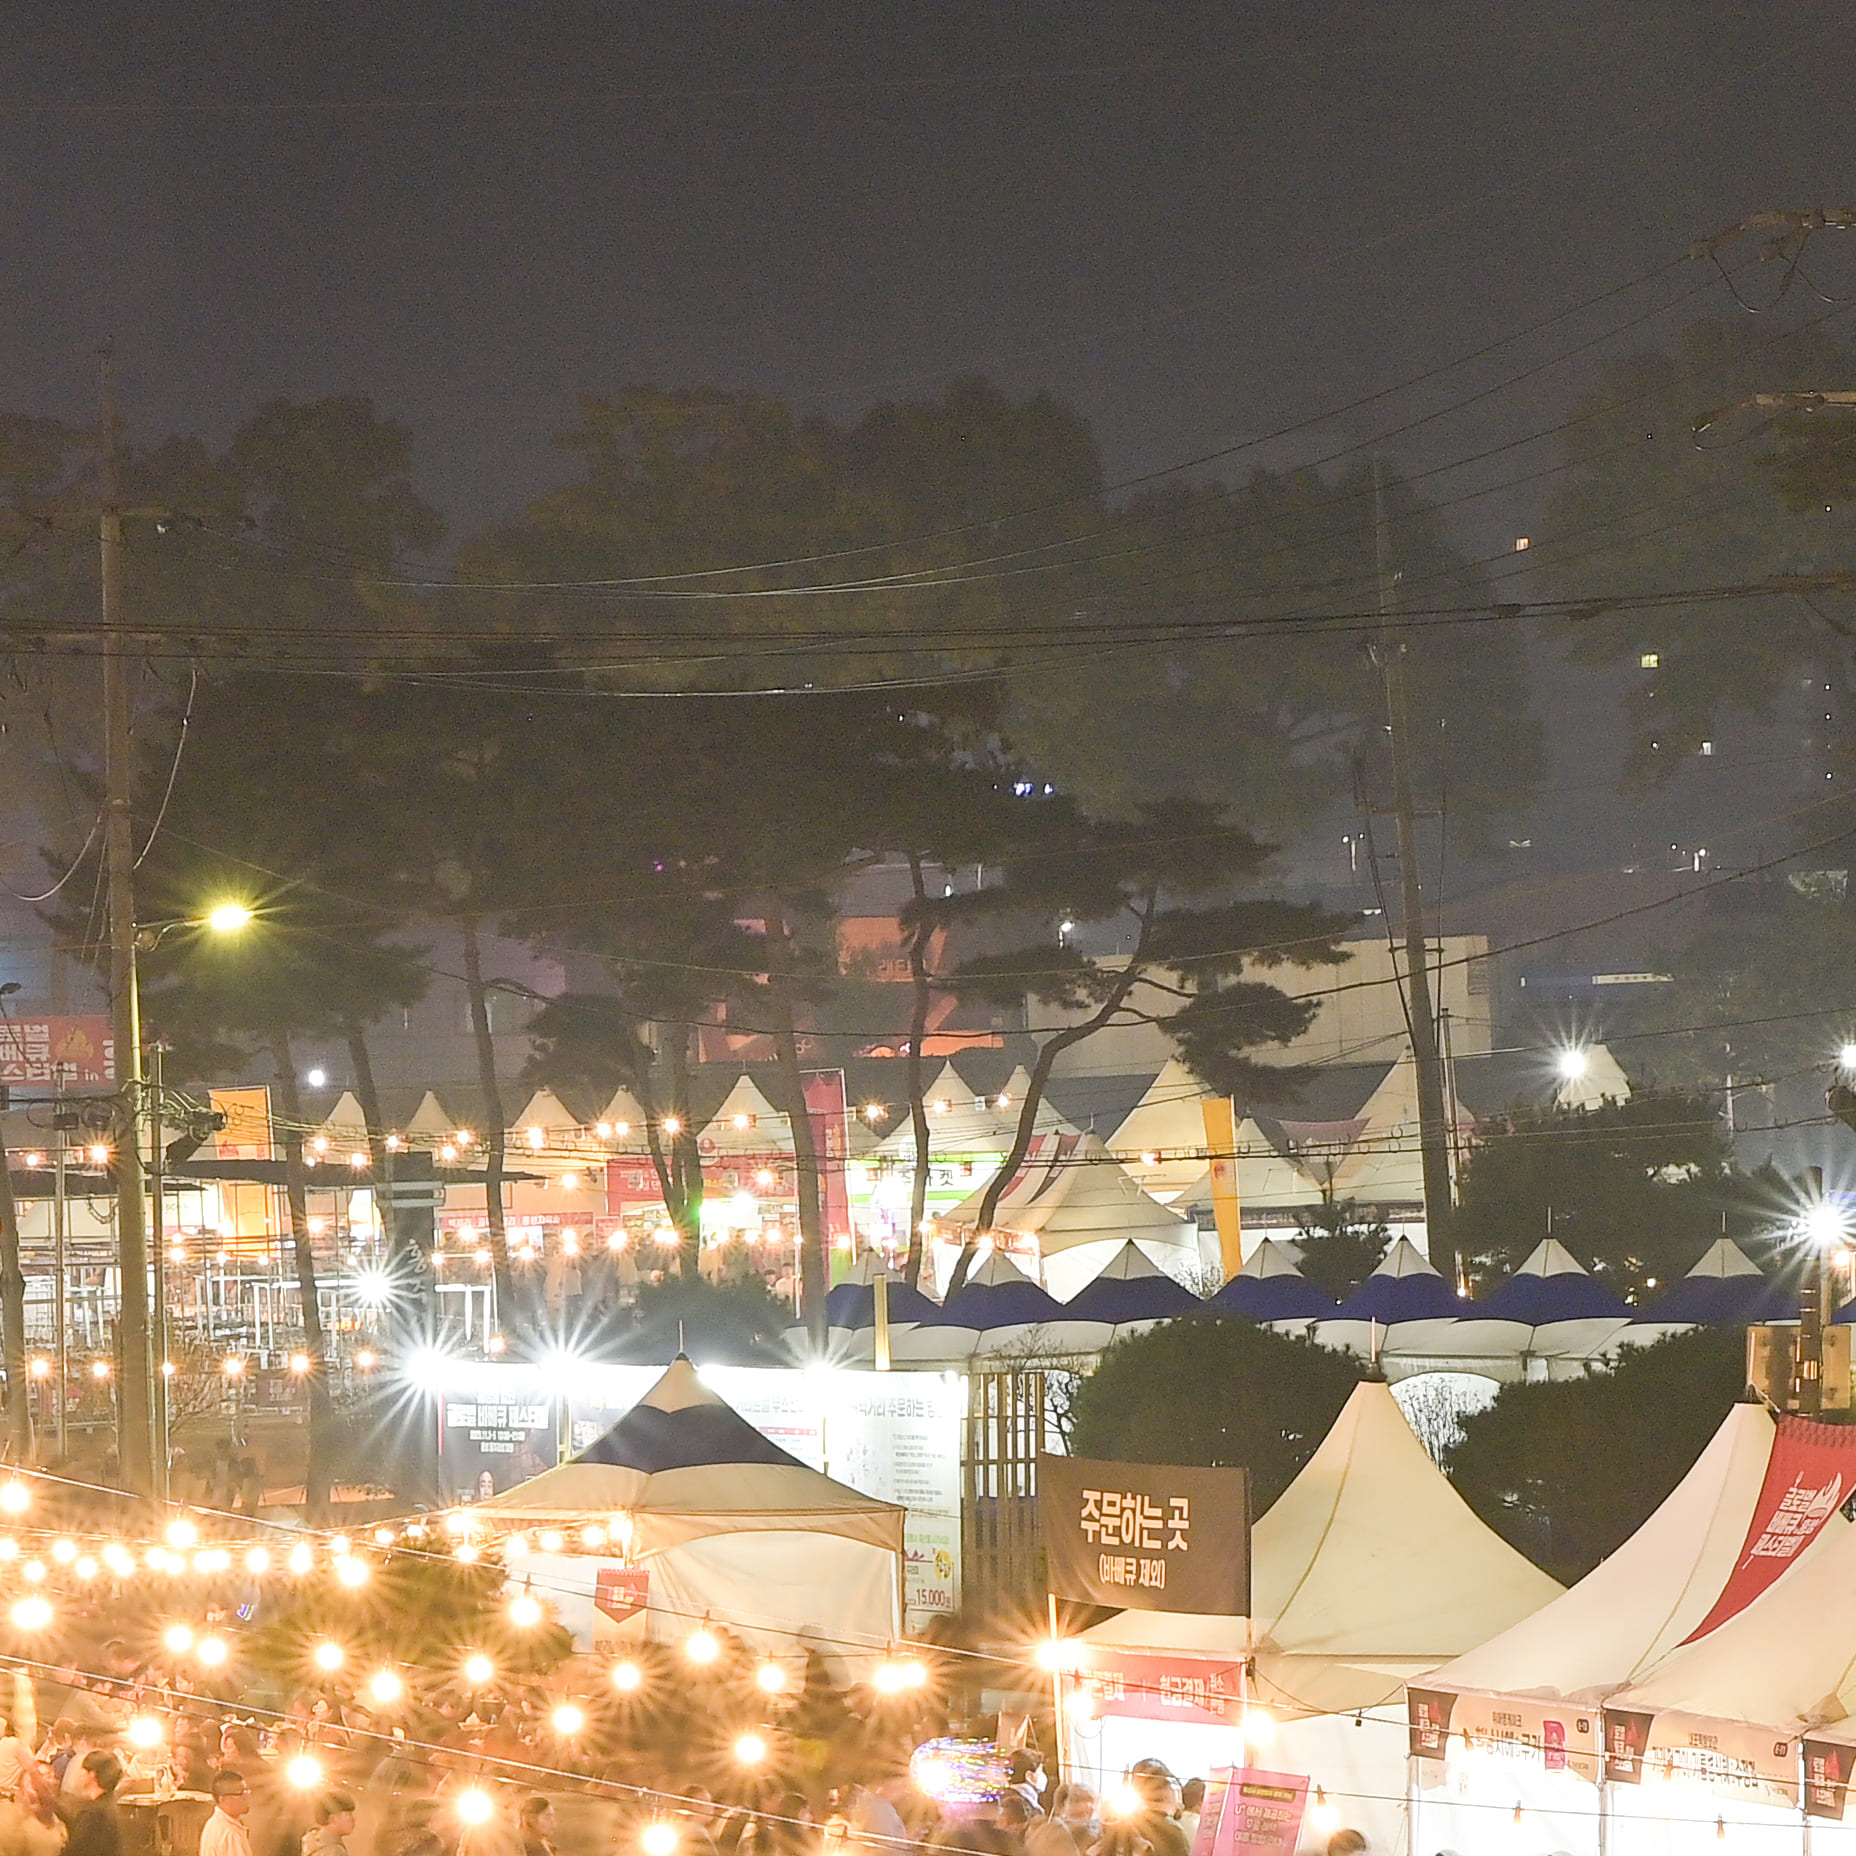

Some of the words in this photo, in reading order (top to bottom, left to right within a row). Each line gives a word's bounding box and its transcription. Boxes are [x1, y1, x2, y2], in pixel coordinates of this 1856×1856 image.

[477, 1404, 508, 1429] 바베큐
[1778, 1487, 1818, 1513] 글로벌
[1080, 1489, 1163, 1549] 주문하는
[1167, 1497, 1190, 1551] 곳
[1750, 1533, 1804, 1557] 페스티벌
[1099, 1553, 1137, 1586] (바베큐
[1139, 1559, 1166, 1590] 제외)
